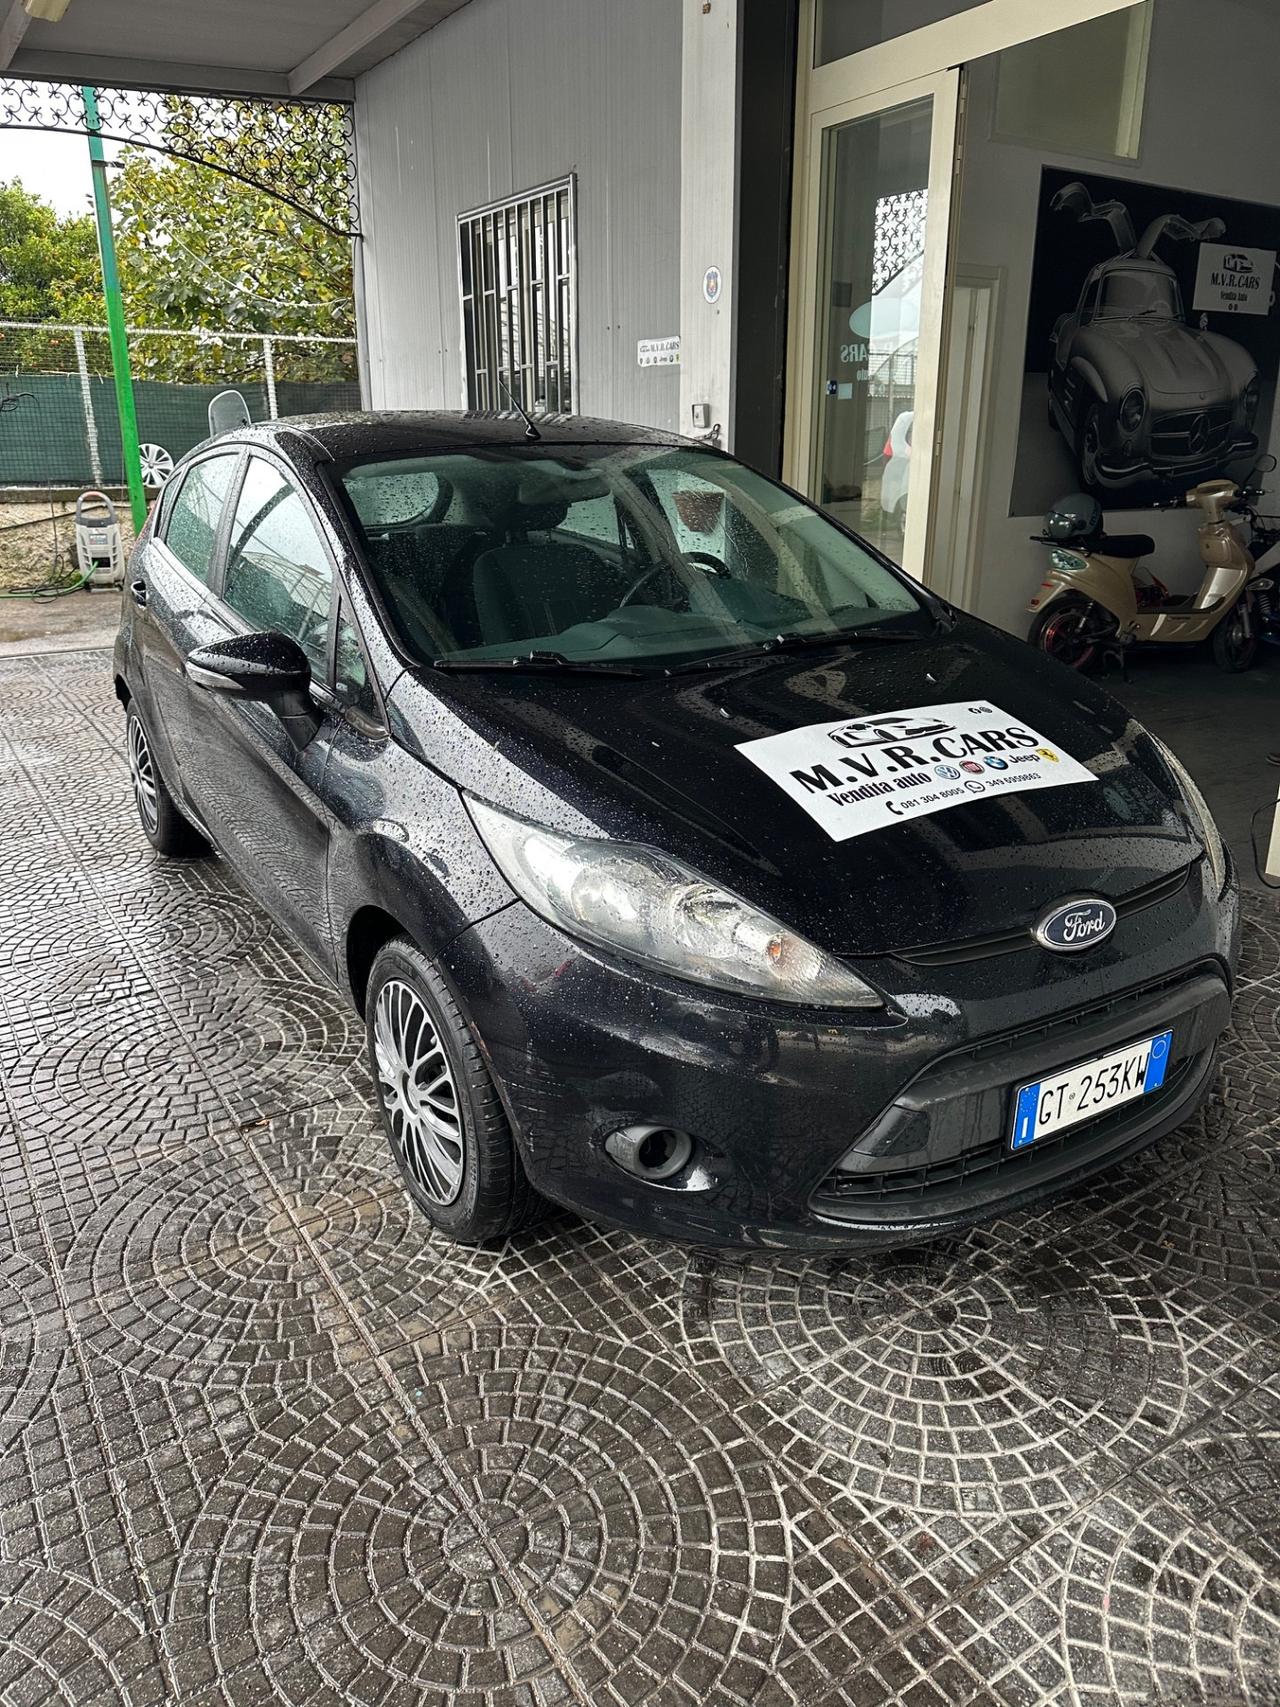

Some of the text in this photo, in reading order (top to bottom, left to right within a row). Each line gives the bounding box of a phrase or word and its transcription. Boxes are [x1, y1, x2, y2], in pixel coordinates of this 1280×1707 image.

[1210, 271, 1261, 290] M.V.R.CARS
[789, 726, 1039, 794] M.V.R.CARS
[1009, 754, 1040, 763] Jeep
[827, 771, 932, 807] Vendita auto
[900, 798, 920, 809] 081
[920, 793, 938, 803] 304
[939, 787, 965, 798] 8005
[985, 779, 1005, 788] 349
[1063, 908, 1105, 941] Ford
[1038, 1083, 1069, 1125] GT
[1076, 1051, 1151, 1112] 253KW
